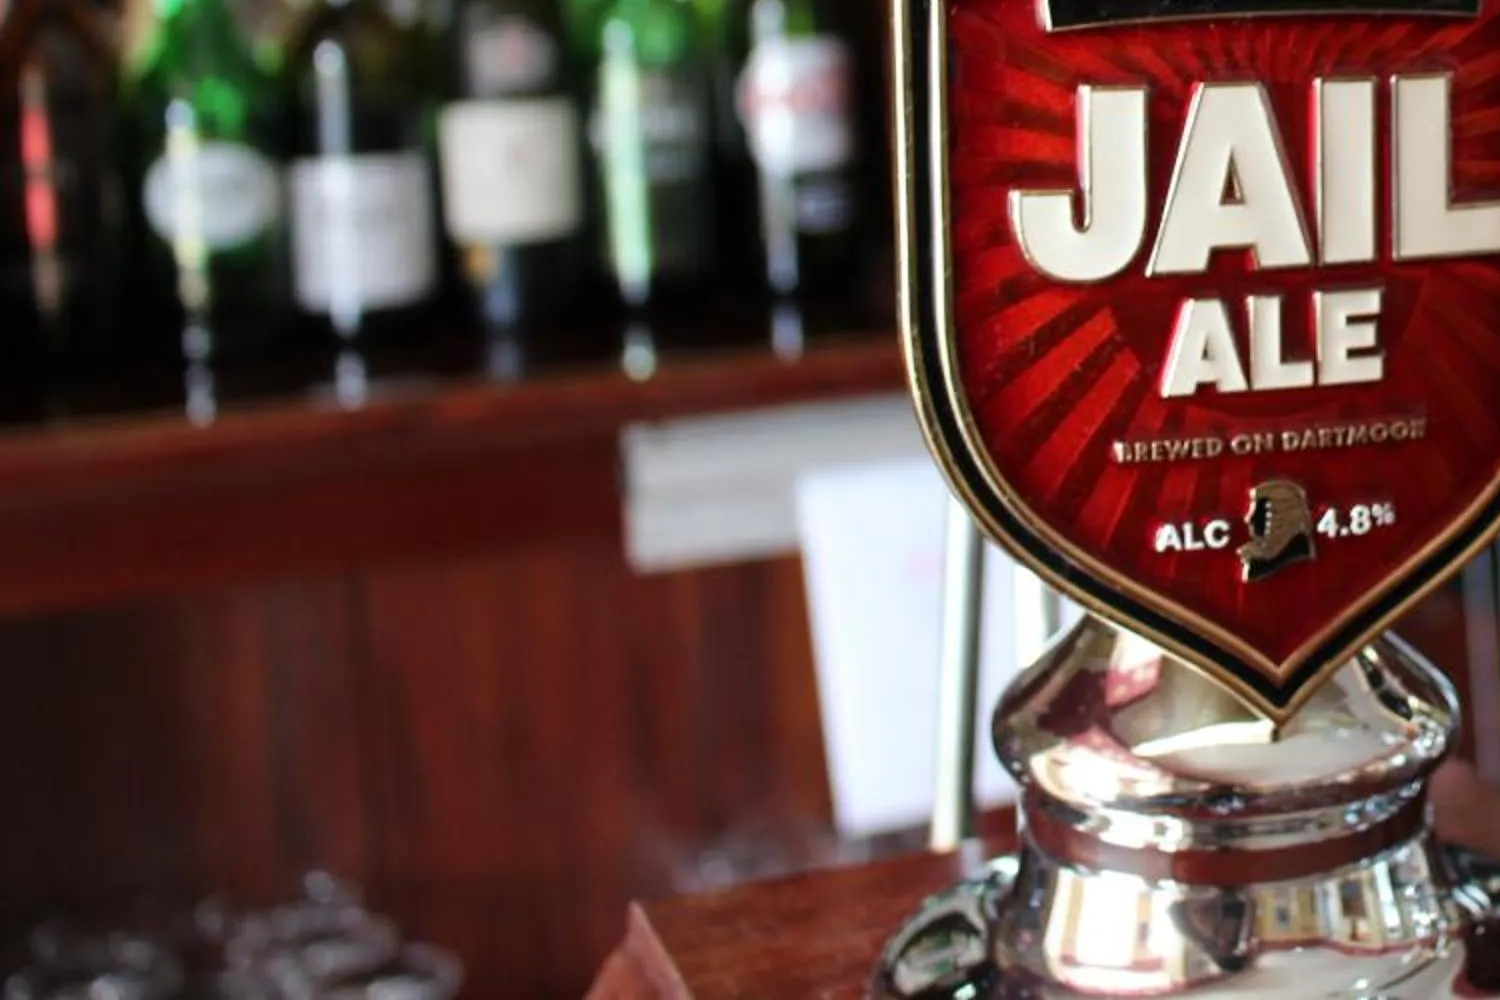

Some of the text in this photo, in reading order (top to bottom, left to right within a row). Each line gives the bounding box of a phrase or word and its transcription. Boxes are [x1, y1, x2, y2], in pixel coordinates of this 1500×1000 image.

[1160, 289, 1384, 399] ALE
[1113, 416, 1427, 463] BREWED ON DARTMOOR
[1154, 501, 1397, 553] ALC 4.8%
